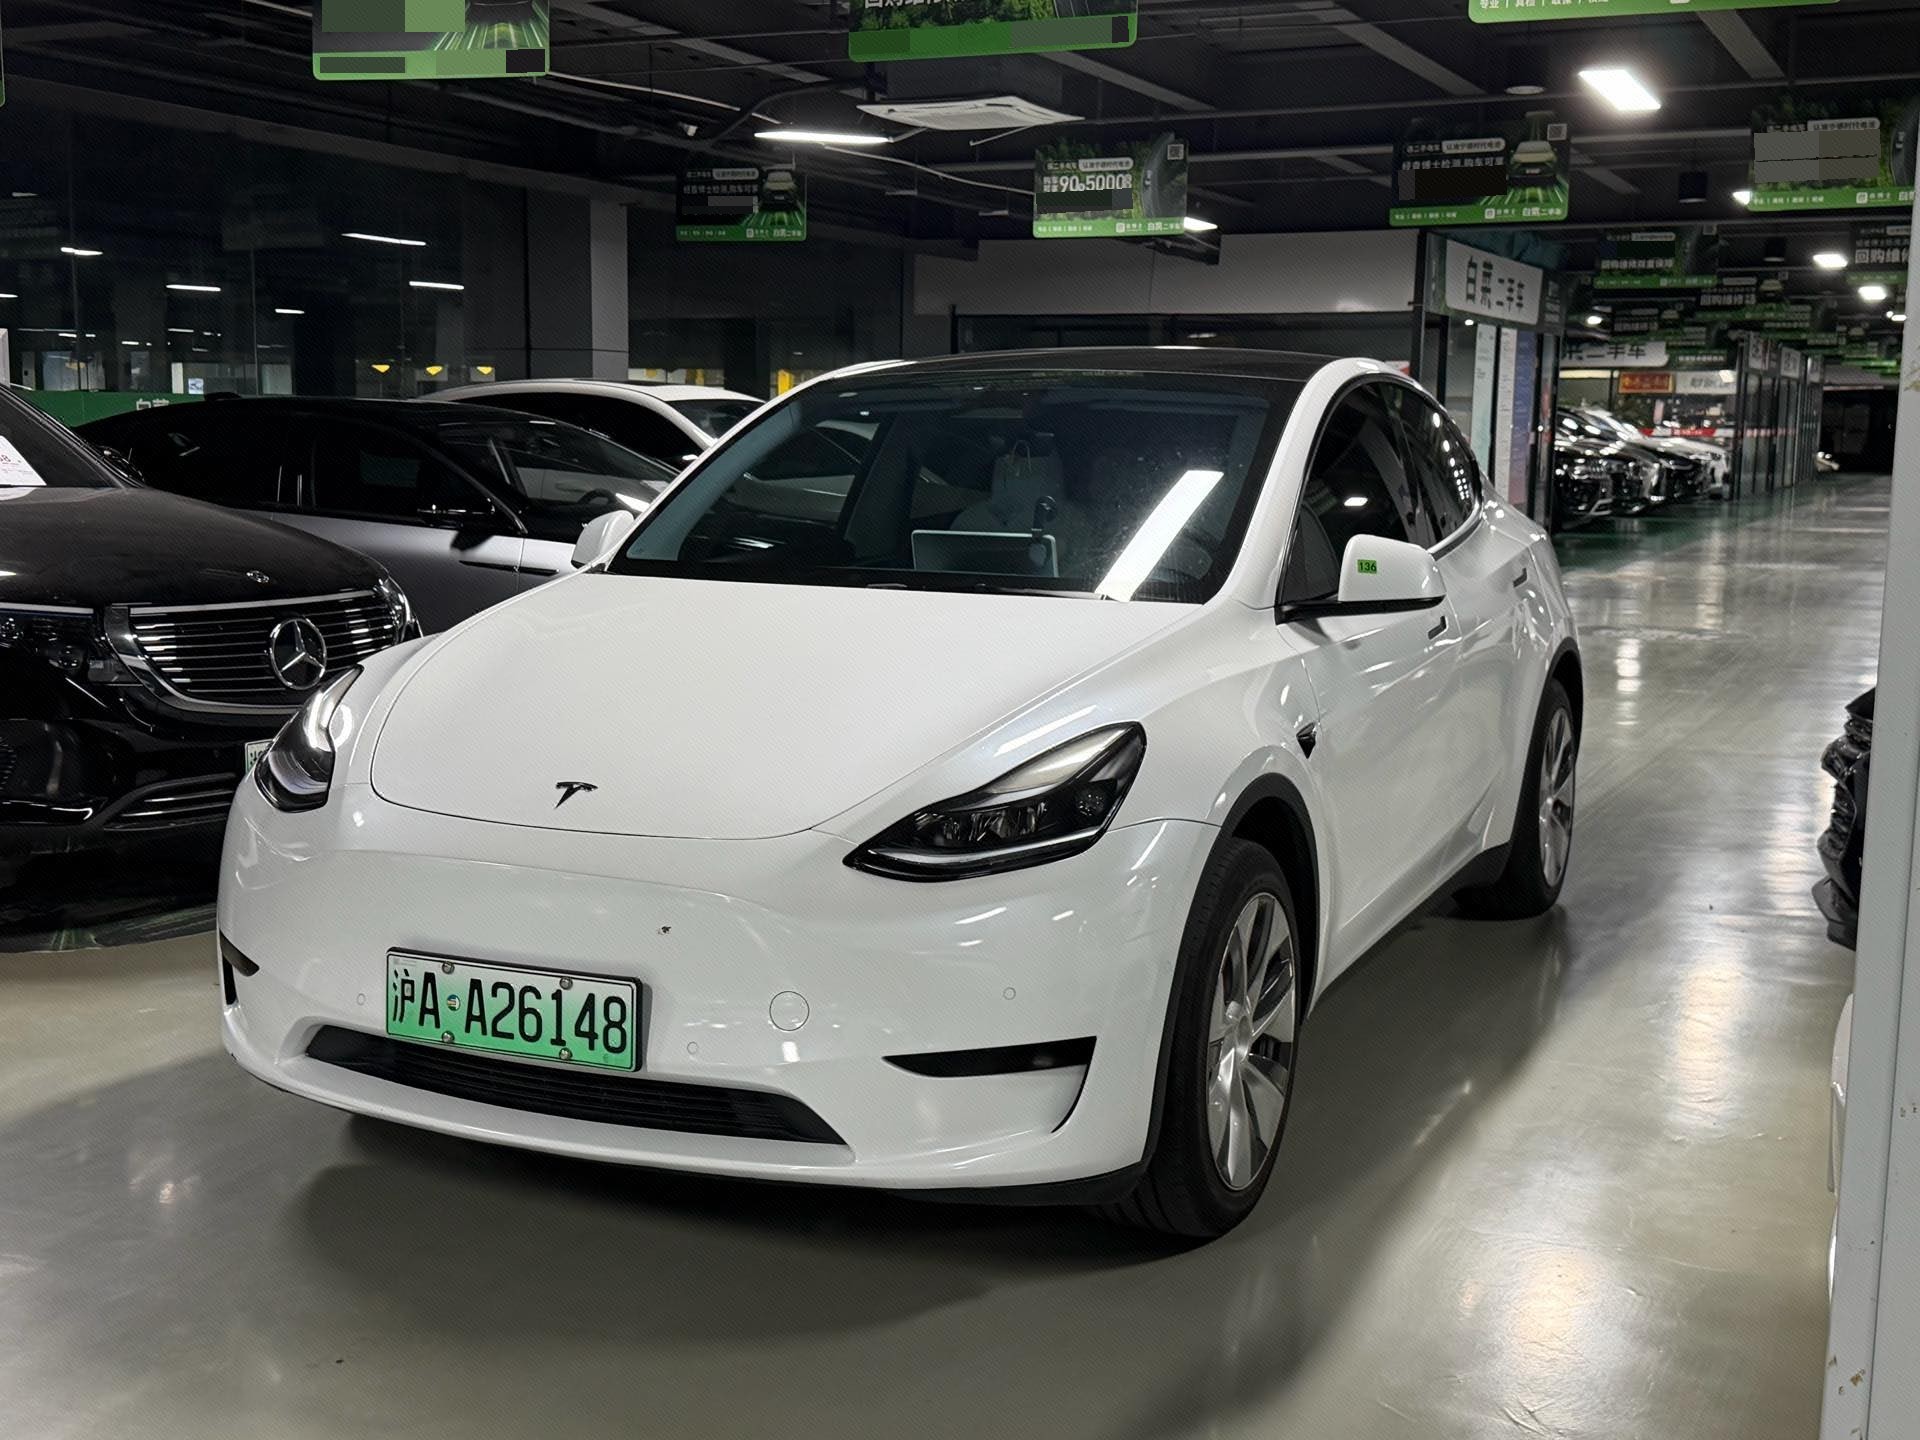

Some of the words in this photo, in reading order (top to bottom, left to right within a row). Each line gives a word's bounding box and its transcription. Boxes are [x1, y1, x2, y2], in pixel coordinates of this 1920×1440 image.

[1359, 562, 1377, 572] 136
[392, 968, 441, 1029] 沪A
[464, 977, 627, 1054] A26148
